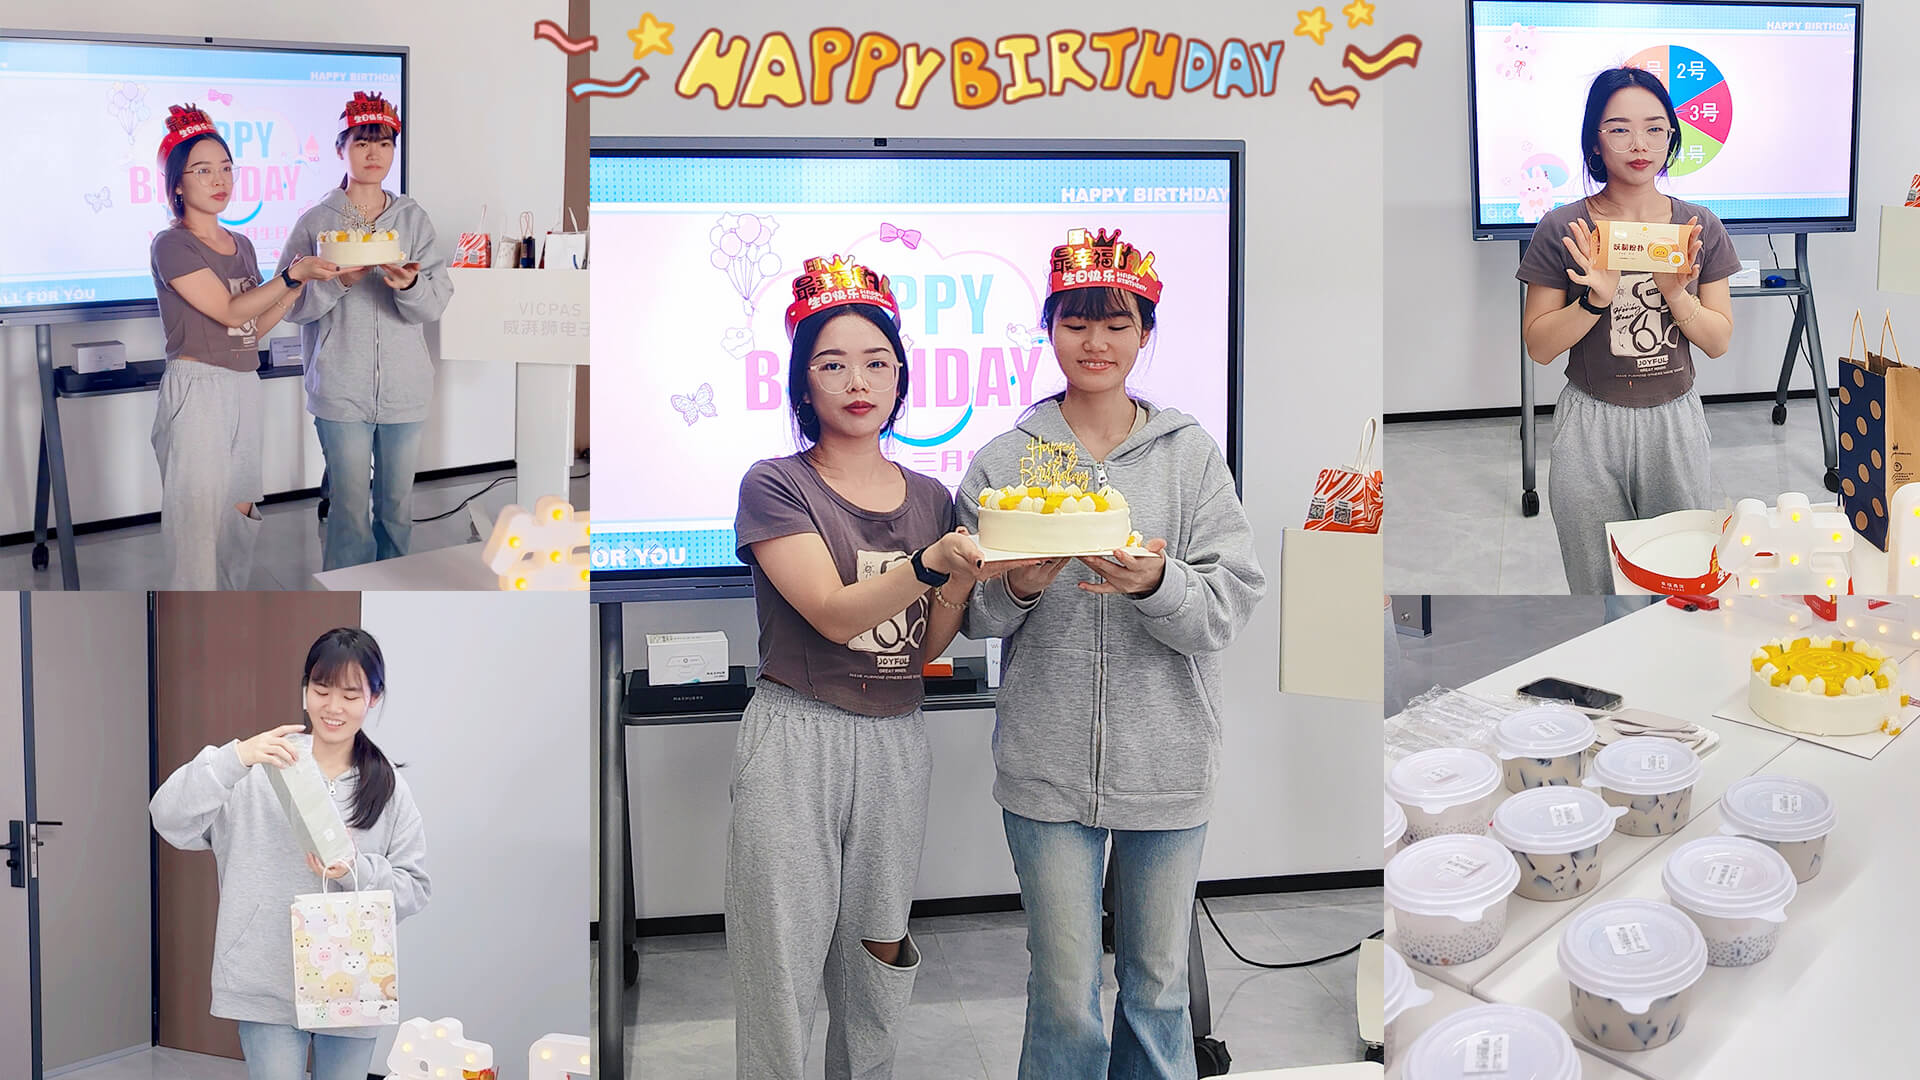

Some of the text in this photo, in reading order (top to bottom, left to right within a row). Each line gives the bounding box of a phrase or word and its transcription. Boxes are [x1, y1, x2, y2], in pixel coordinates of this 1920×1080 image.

[1767, 21, 1802, 31] HAPPY
[310, 71, 347, 81] HAPPY
[1676, 61, 1707, 80] 2号
[1689, 103, 1720, 123] 3号
[1061, 187, 1229, 203] HAPPY BIRTHDAY
[1062, 269, 1115, 287] 生日快乐
[63, 287, 97, 301] YOU
[807, 287, 860, 310] 生日快乐
[519, 302, 582, 317] VICPAS
[890, 274, 994, 335] PPY
[1638, 357, 1667, 366] JOYFUL
[591, 546, 686, 568] OR YOU
[878, 657, 908, 666] JOYFUL
